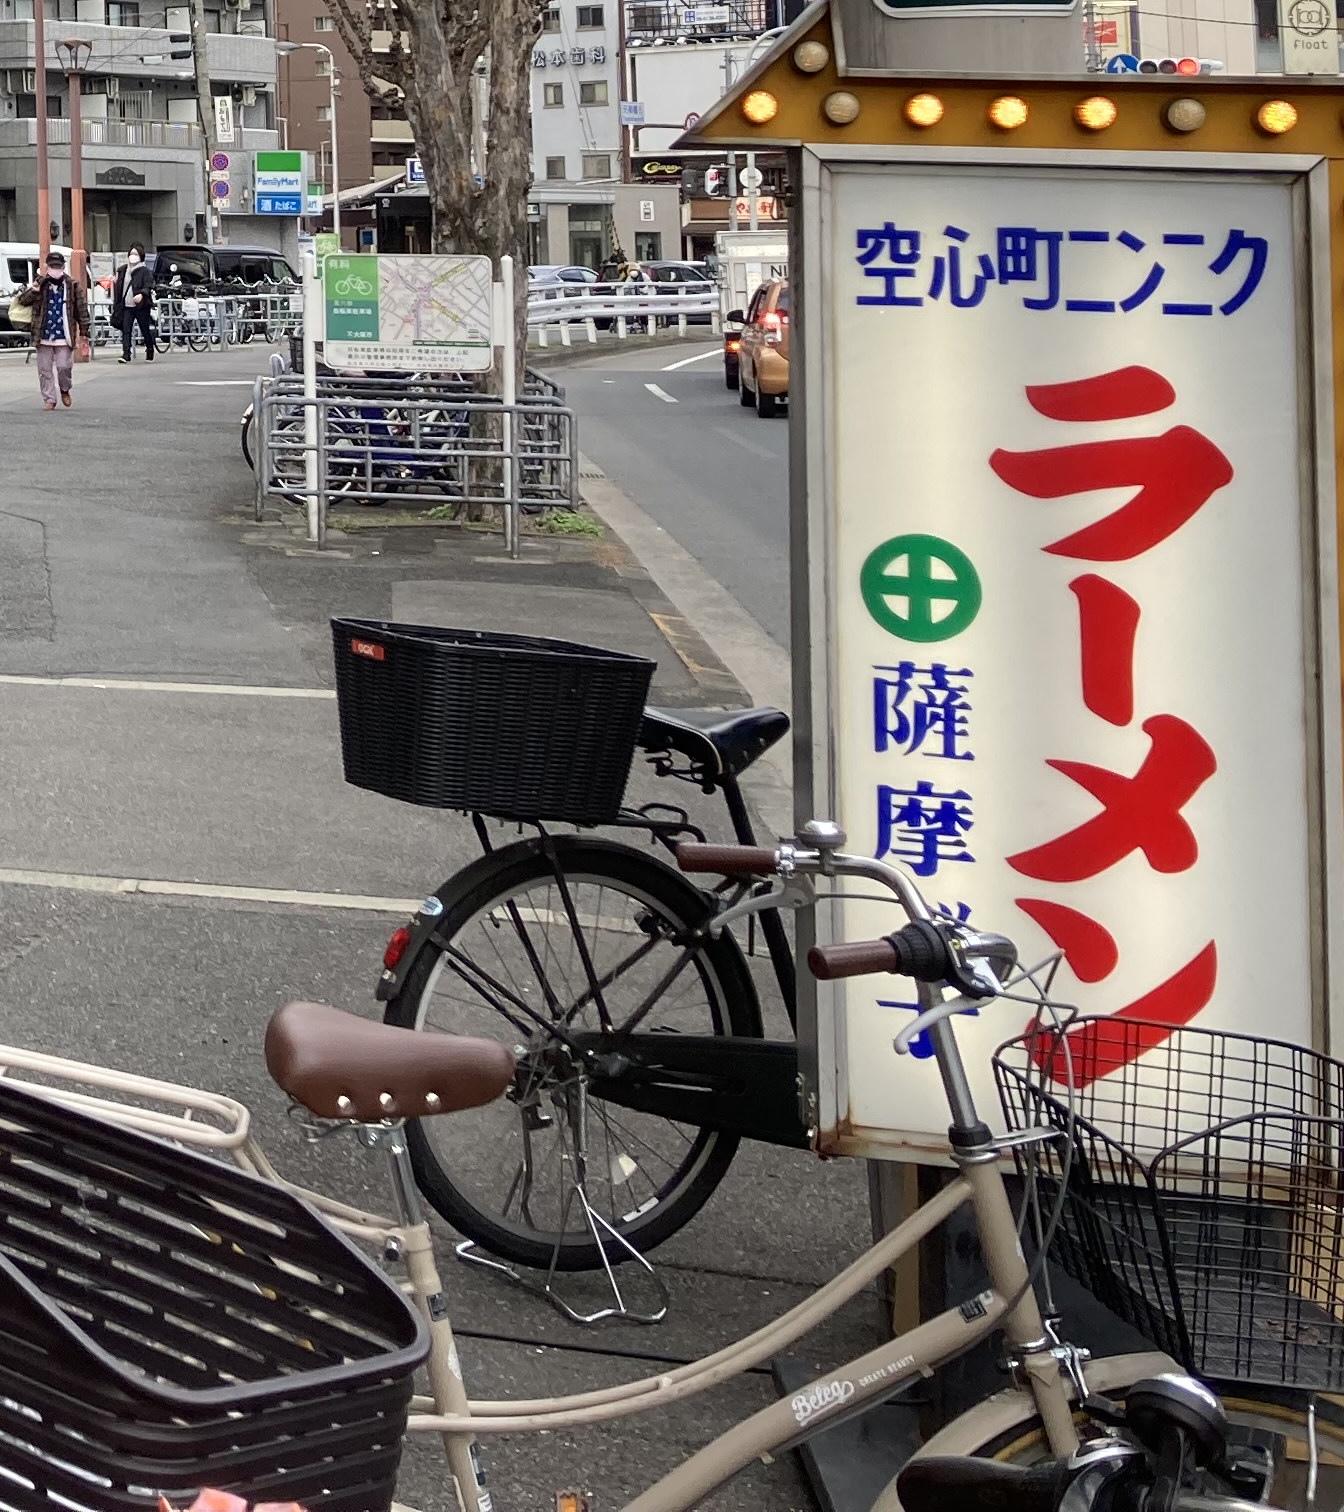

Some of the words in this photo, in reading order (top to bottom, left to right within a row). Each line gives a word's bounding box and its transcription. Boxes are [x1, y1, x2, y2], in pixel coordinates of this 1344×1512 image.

[532, 46, 606, 69] 松本歯科
[257, 177, 299, 188] FamilyMart
[853, 220, 1270, 318] 空心町ニンニク
[988, 363, 1234, 1090] ラーメン
